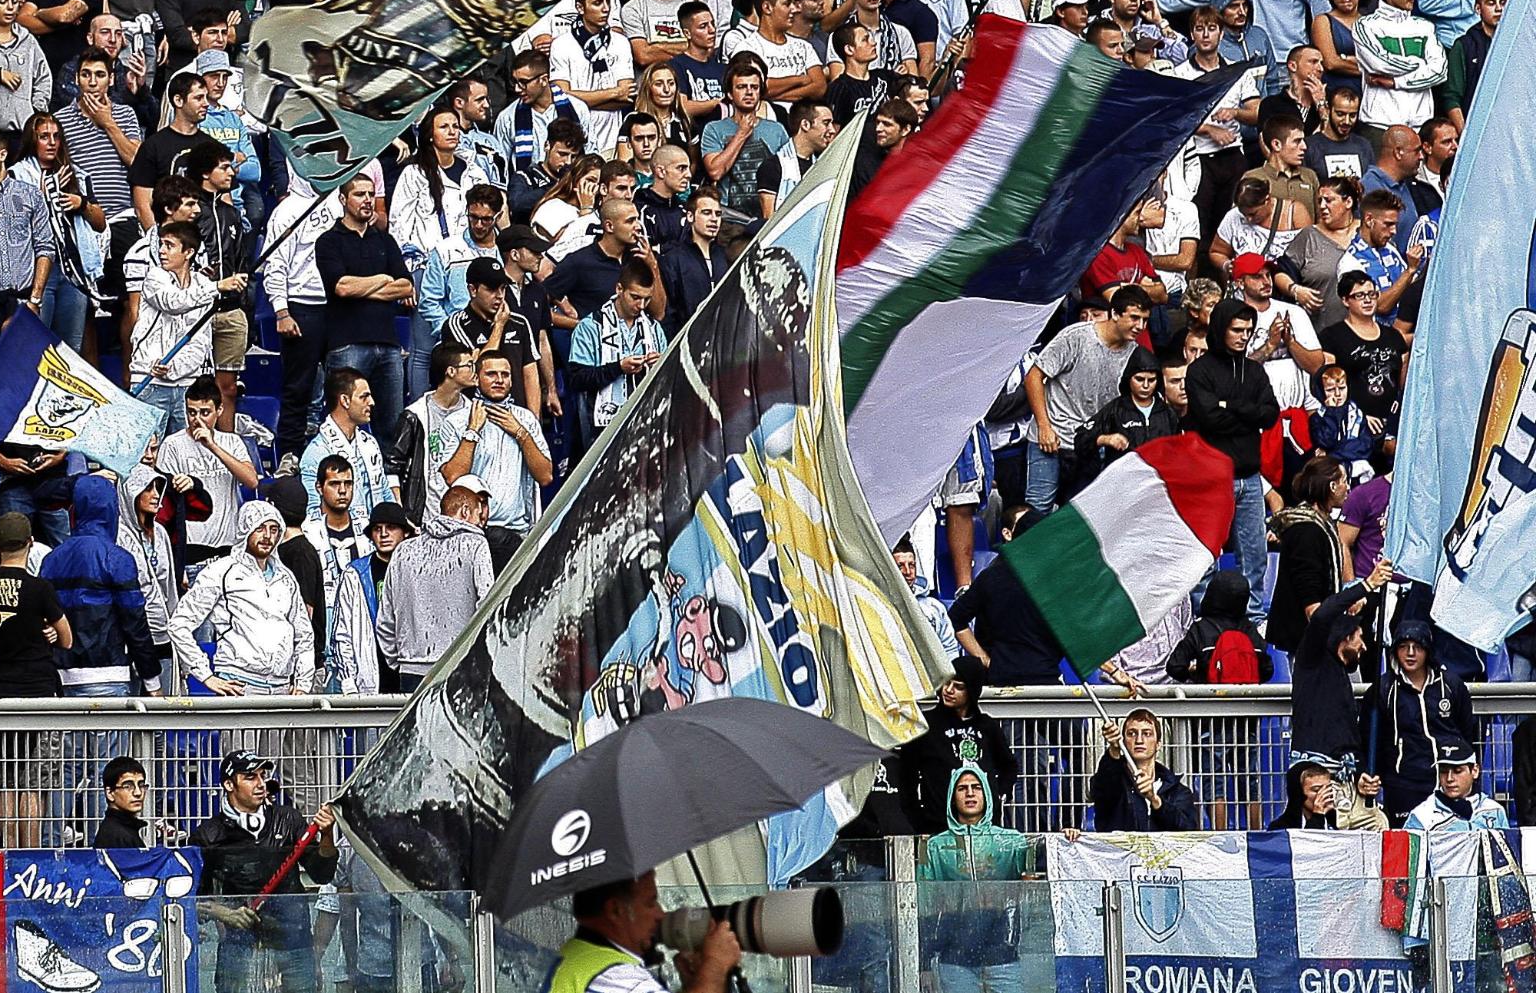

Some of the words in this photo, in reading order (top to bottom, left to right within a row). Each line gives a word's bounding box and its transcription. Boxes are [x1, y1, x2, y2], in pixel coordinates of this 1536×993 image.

[4, 864, 91, 908] Anni
[530, 849, 607, 886] INESIS
[1124, 967, 1258, 993] ROMANA
